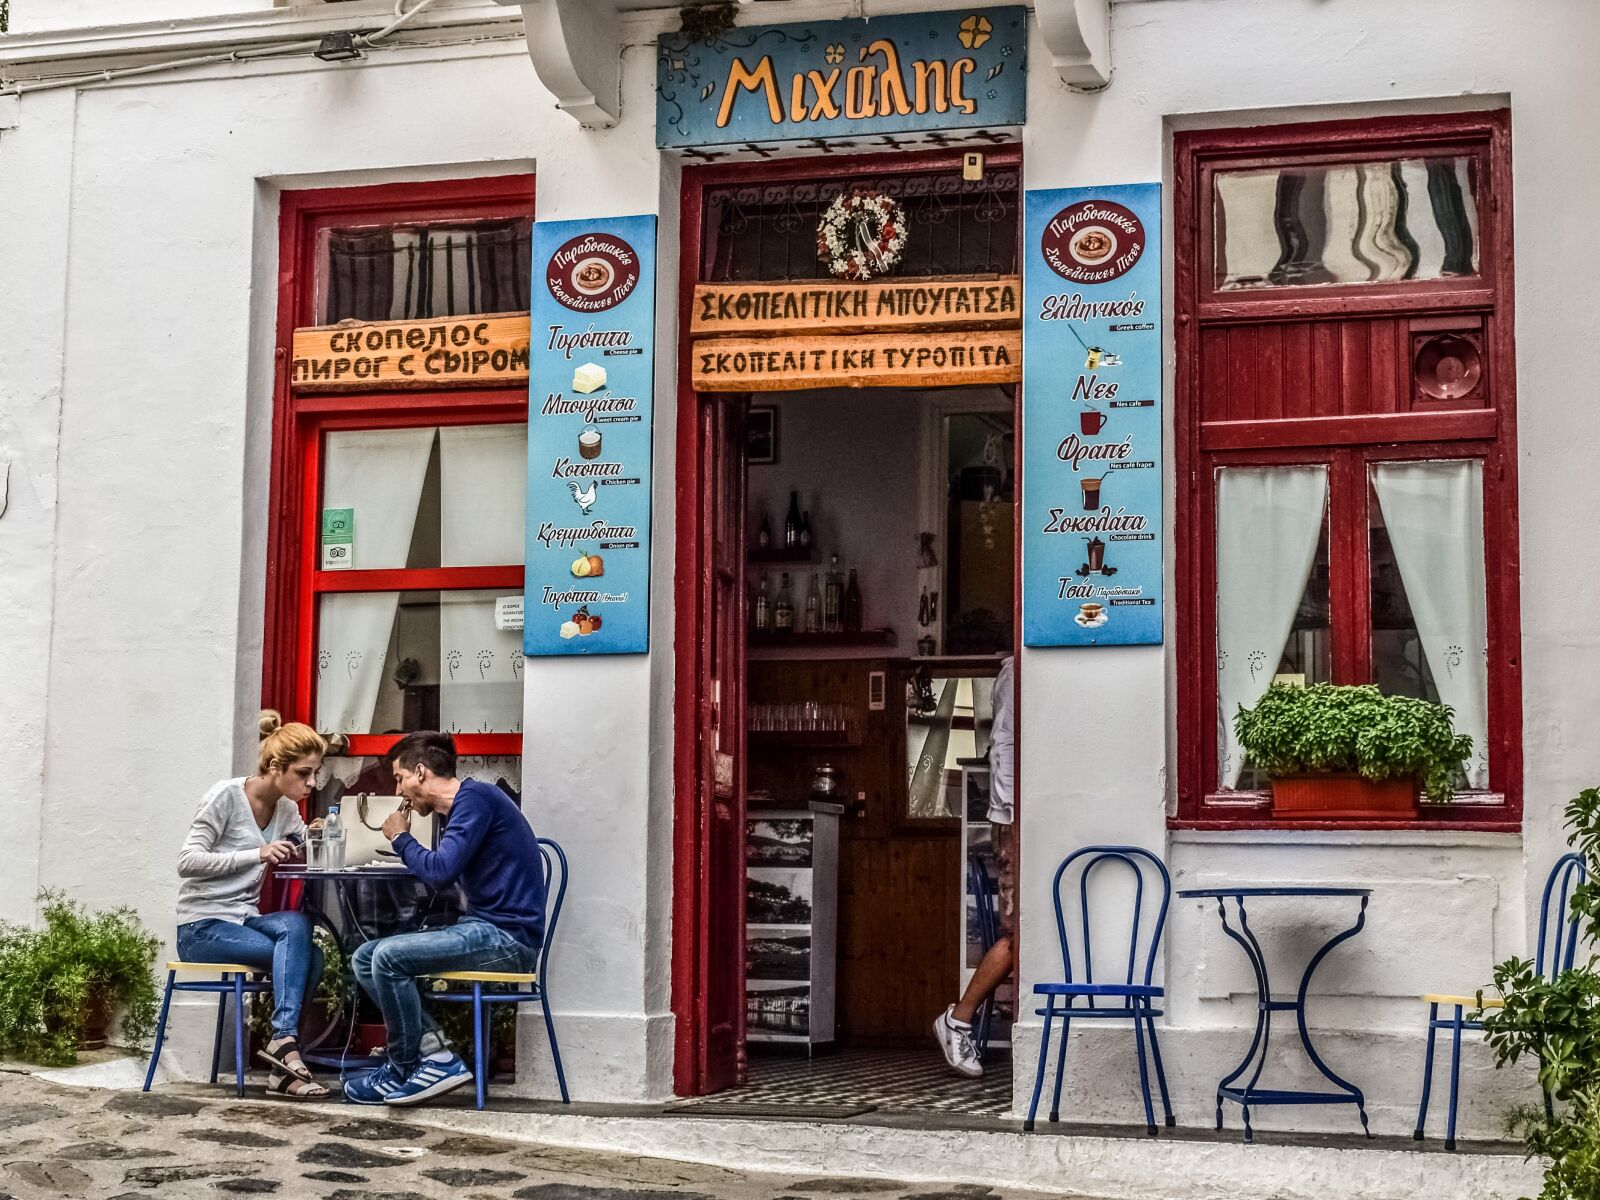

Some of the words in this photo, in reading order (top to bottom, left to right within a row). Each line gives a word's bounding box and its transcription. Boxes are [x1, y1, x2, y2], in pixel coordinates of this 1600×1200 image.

[715, 38, 978, 129] Μιχάλης
[1049, 203, 1136, 239] Παραδοσιακές
[553, 236, 633, 270] Παραδοσιακές
[1045, 247, 1115, 281] Σκοπελίτικες
[1116, 242, 1141, 272] Πίτες
[549, 277, 612, 310] Σκοπελίτικες
[613, 273, 636, 302] Πίτες
[700, 289, 868, 321] ΣΚΟΠΕΛΙΤΙΚΗ
[876, 285, 1016, 317] ΜΠΟΥΓΑΤΣΑ
[1039, 292, 1145, 323] Ελληνικός
[547, 324, 634, 360] Τυρόπιτα
[700, 349, 875, 375] ΣΚΟΠΕΛΙΤΙΚΗ
[883, 345, 1011, 369] ΤΥΡΟΠΙΤΑ
[541, 392, 637, 424] Μπουγάτσα
[630, 415, 639, 423] pie
[552, 457, 624, 479] Κοτόπιτα
[1056, 433, 1132, 472] Φραπέ
[626, 478, 636, 486] pie
[537, 520, 637, 549] Κρεμμυδόπιτα
[1043, 506, 1147, 534] Σοκολάτα
[625, 542, 635, 550] pie
[542, 585, 601, 611] Τυρόπιτα
[1057, 577, 1095, 600] Τσάι
